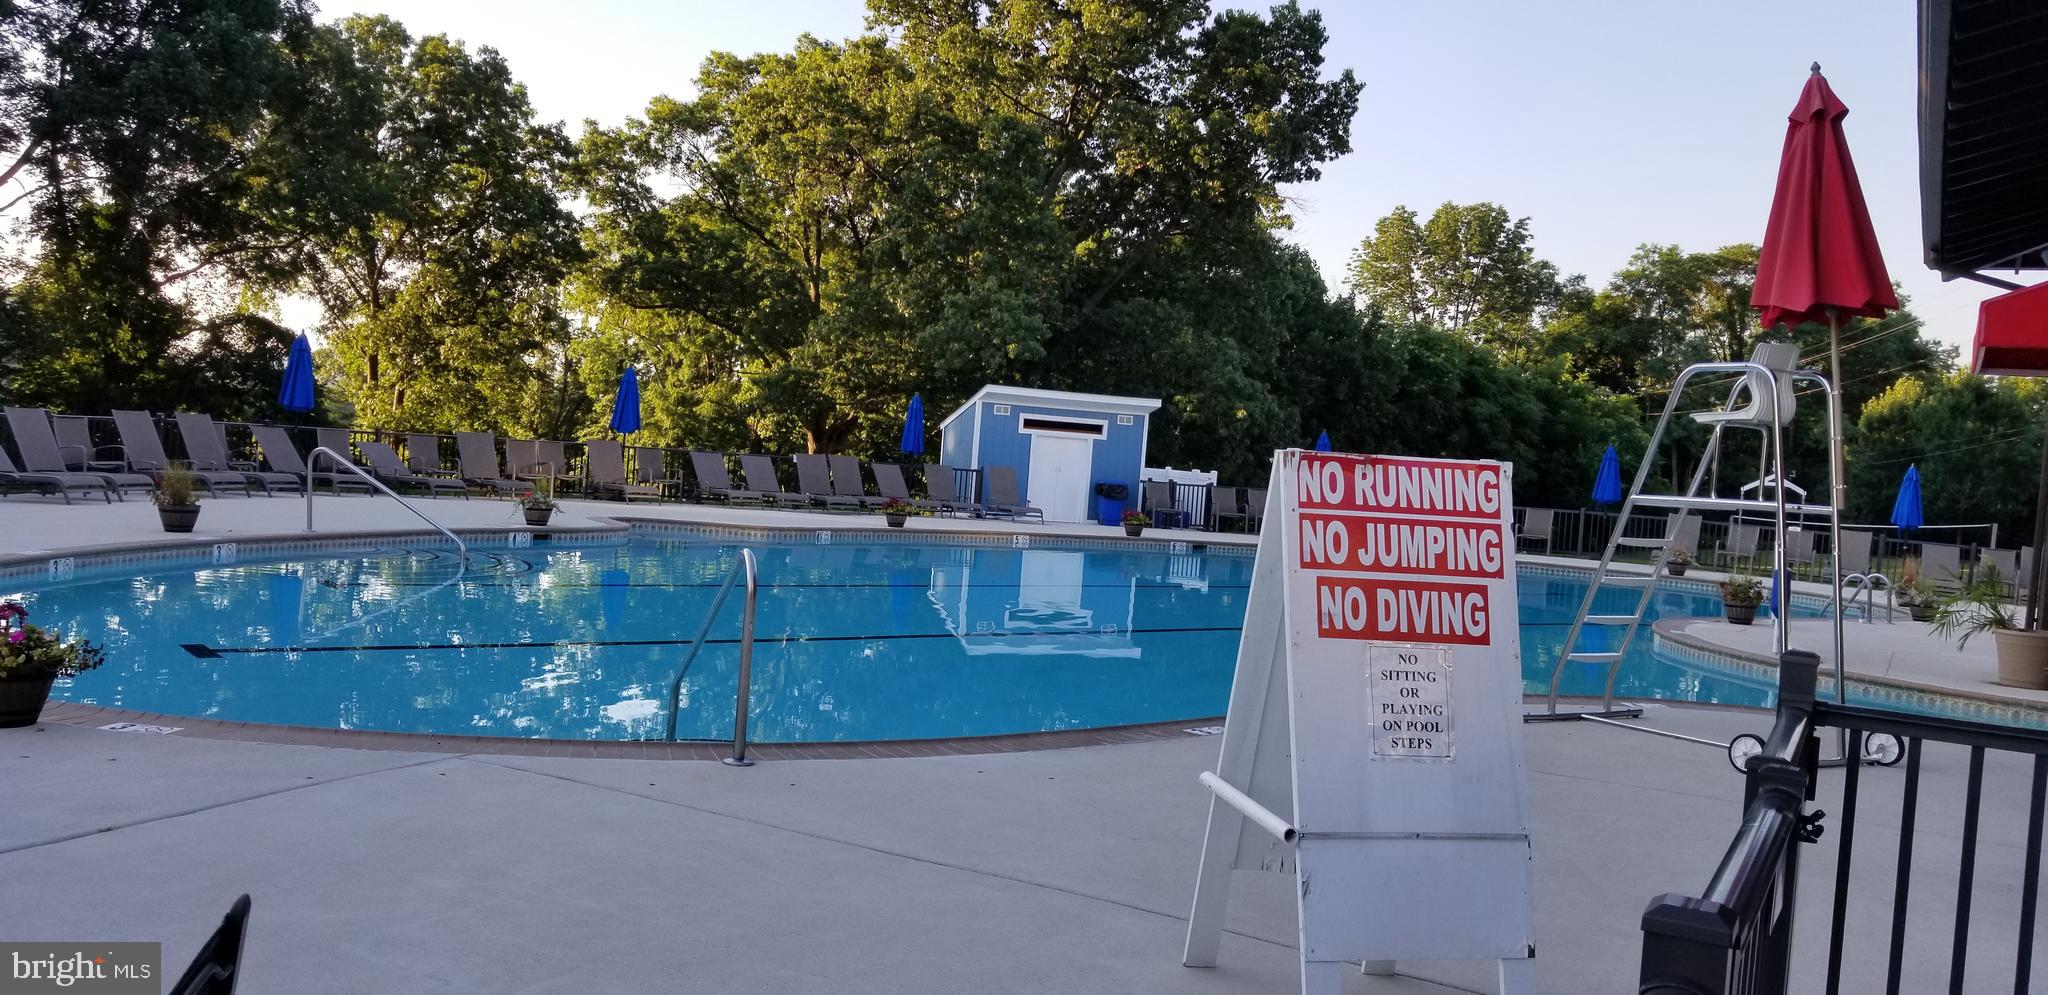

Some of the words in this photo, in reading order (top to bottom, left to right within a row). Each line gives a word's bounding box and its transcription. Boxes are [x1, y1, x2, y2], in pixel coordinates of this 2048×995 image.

[1299, 460, 1345, 505] NO
[1354, 463, 1500, 514] RUNNING
[1302, 519, 1349, 565] NO
[1357, 522, 1501, 573] JUMPING
[1320, 585, 1367, 631] NO
[1376, 587, 1486, 637] DIVING
[1398, 653, 1418, 666] NO
[1381, 669, 1436, 683] SITTING
[1400, 687, 1420, 699] OR
[1382, 703, 1443, 716] PLAYING
[1382, 720, 1402, 732] ON
[1406, 720, 1444, 733] POOL
[1391, 737, 1432, 749] STEPS
